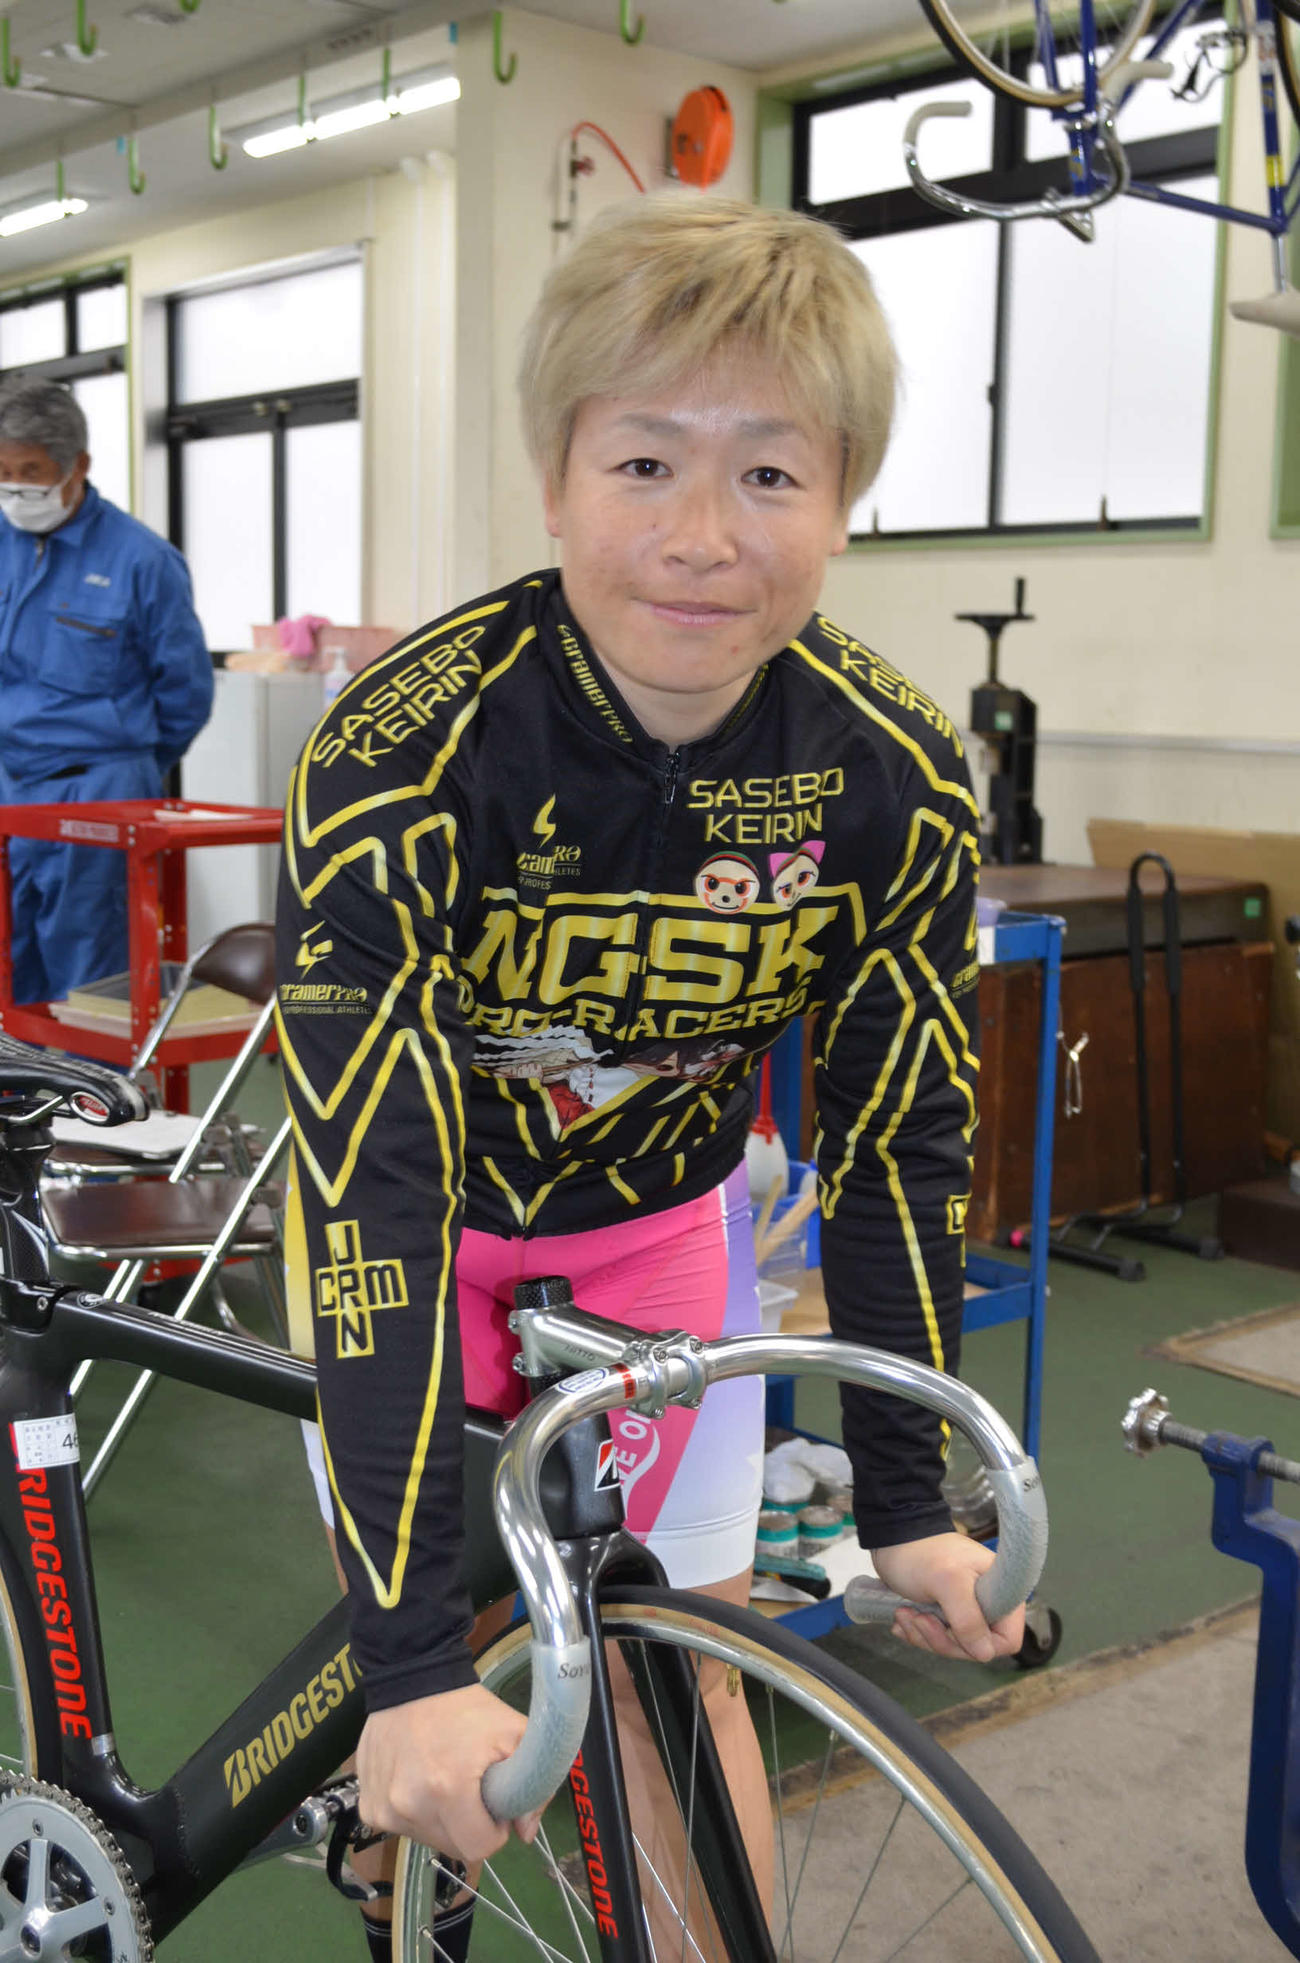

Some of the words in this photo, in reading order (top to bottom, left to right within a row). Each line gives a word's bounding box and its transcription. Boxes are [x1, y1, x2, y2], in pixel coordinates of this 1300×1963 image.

[311, 625, 486, 767] SASEBO
[348, 649, 483, 767] KEIRIN
[840, 649, 965, 759] KEIRIN
[686, 767, 844, 809] SASEBO
[704, 803, 823, 844] KEIRIN
[461, 905, 839, 1005] NGSK
[8, 1422, 93, 1740] RIDGESTONE
[224, 1642, 363, 1808] BRIDGEST
